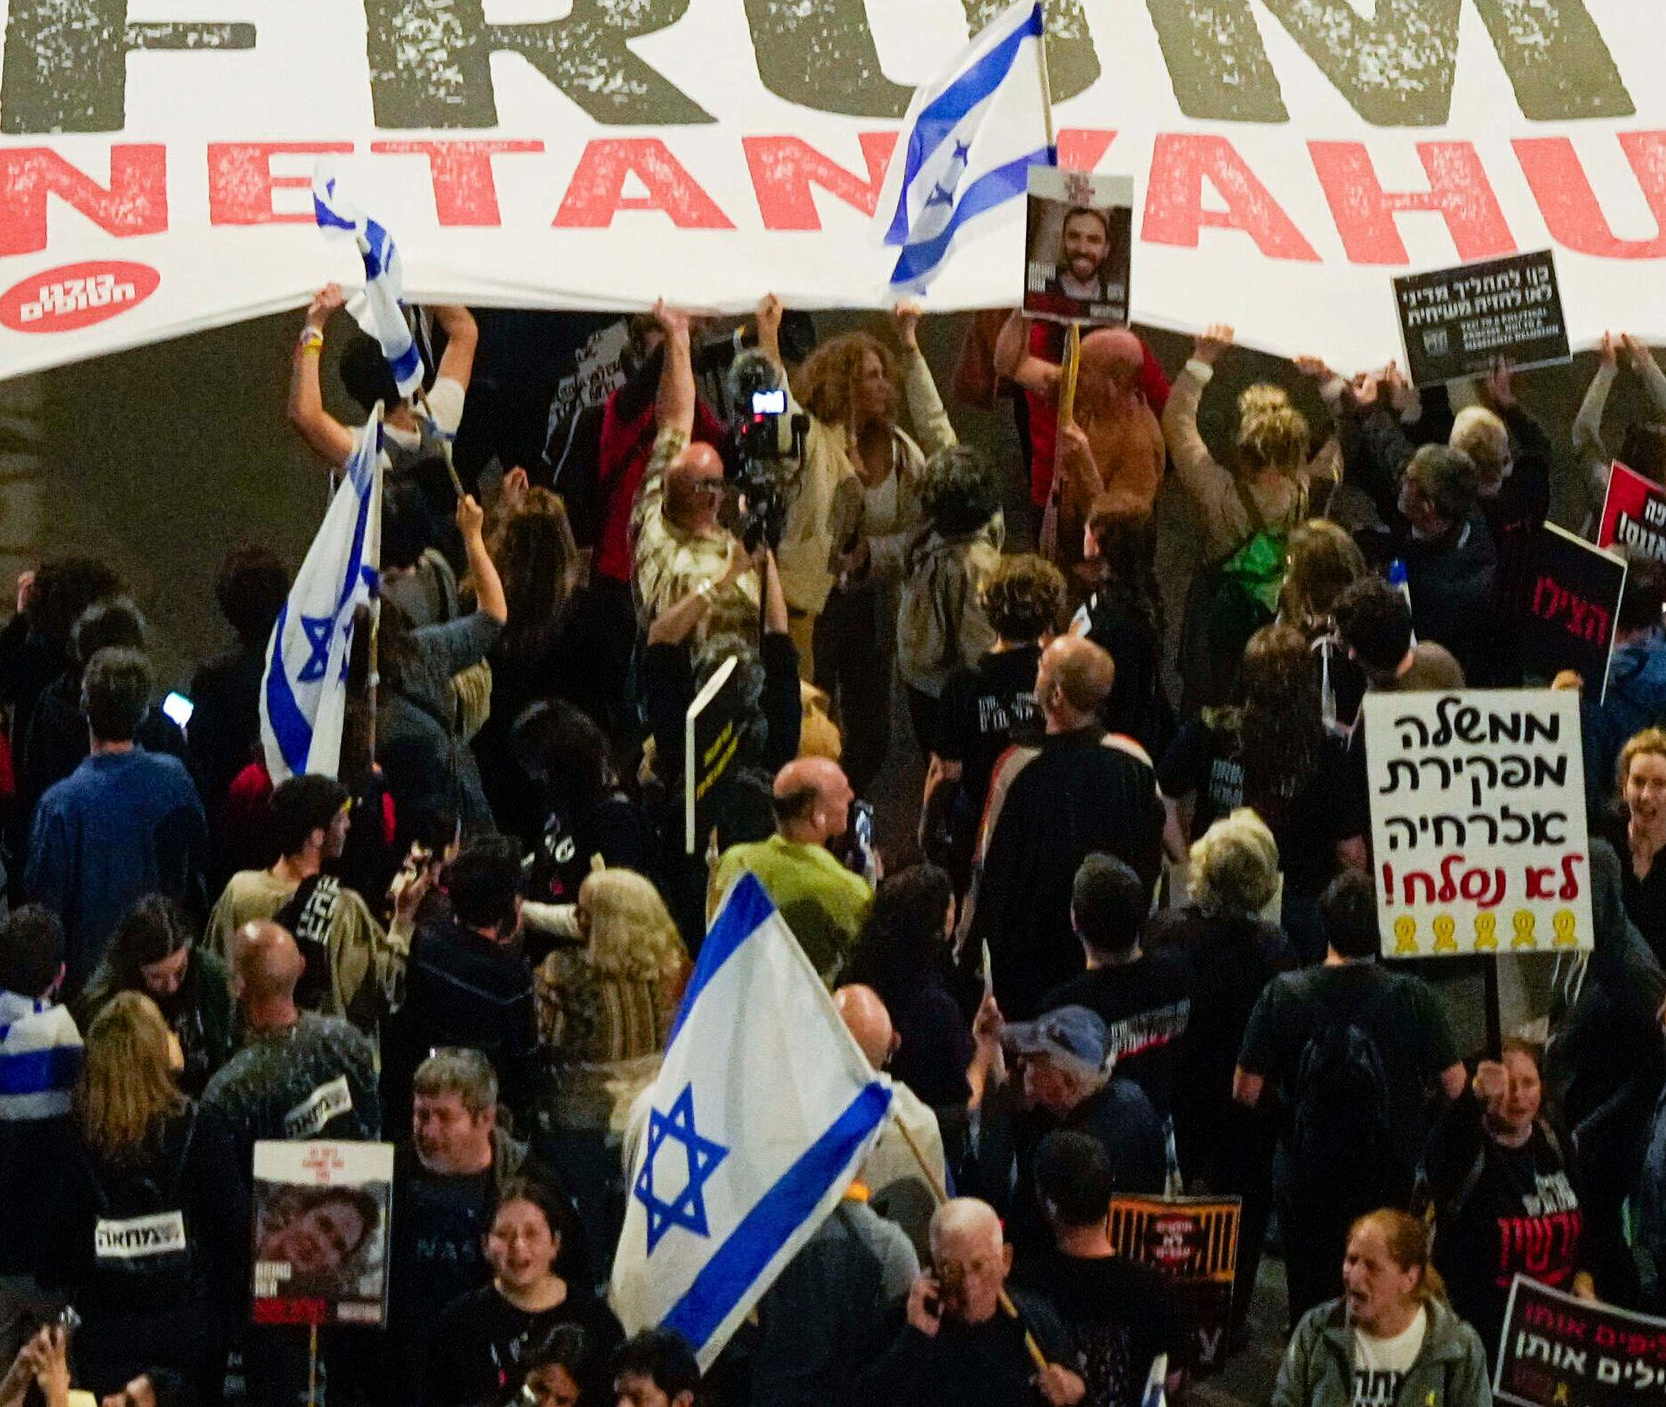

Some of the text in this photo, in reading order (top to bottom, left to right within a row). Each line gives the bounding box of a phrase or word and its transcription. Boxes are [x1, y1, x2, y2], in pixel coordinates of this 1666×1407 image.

[20, 282, 135, 323] חטופים
[39, 274, 115, 304] כולנו
[1452, 269, 1521, 300] לתהליך
[1407, 299, 1471, 327] משיחית
[1532, 577, 1609, 646] הצילו
[1394, 697, 1561, 750] ממשלה
[1379, 754, 1569, 808] מפקירת
[1383, 854, 1584, 909] לא נסלח!
[1513, 1329, 1587, 1374] אותן
